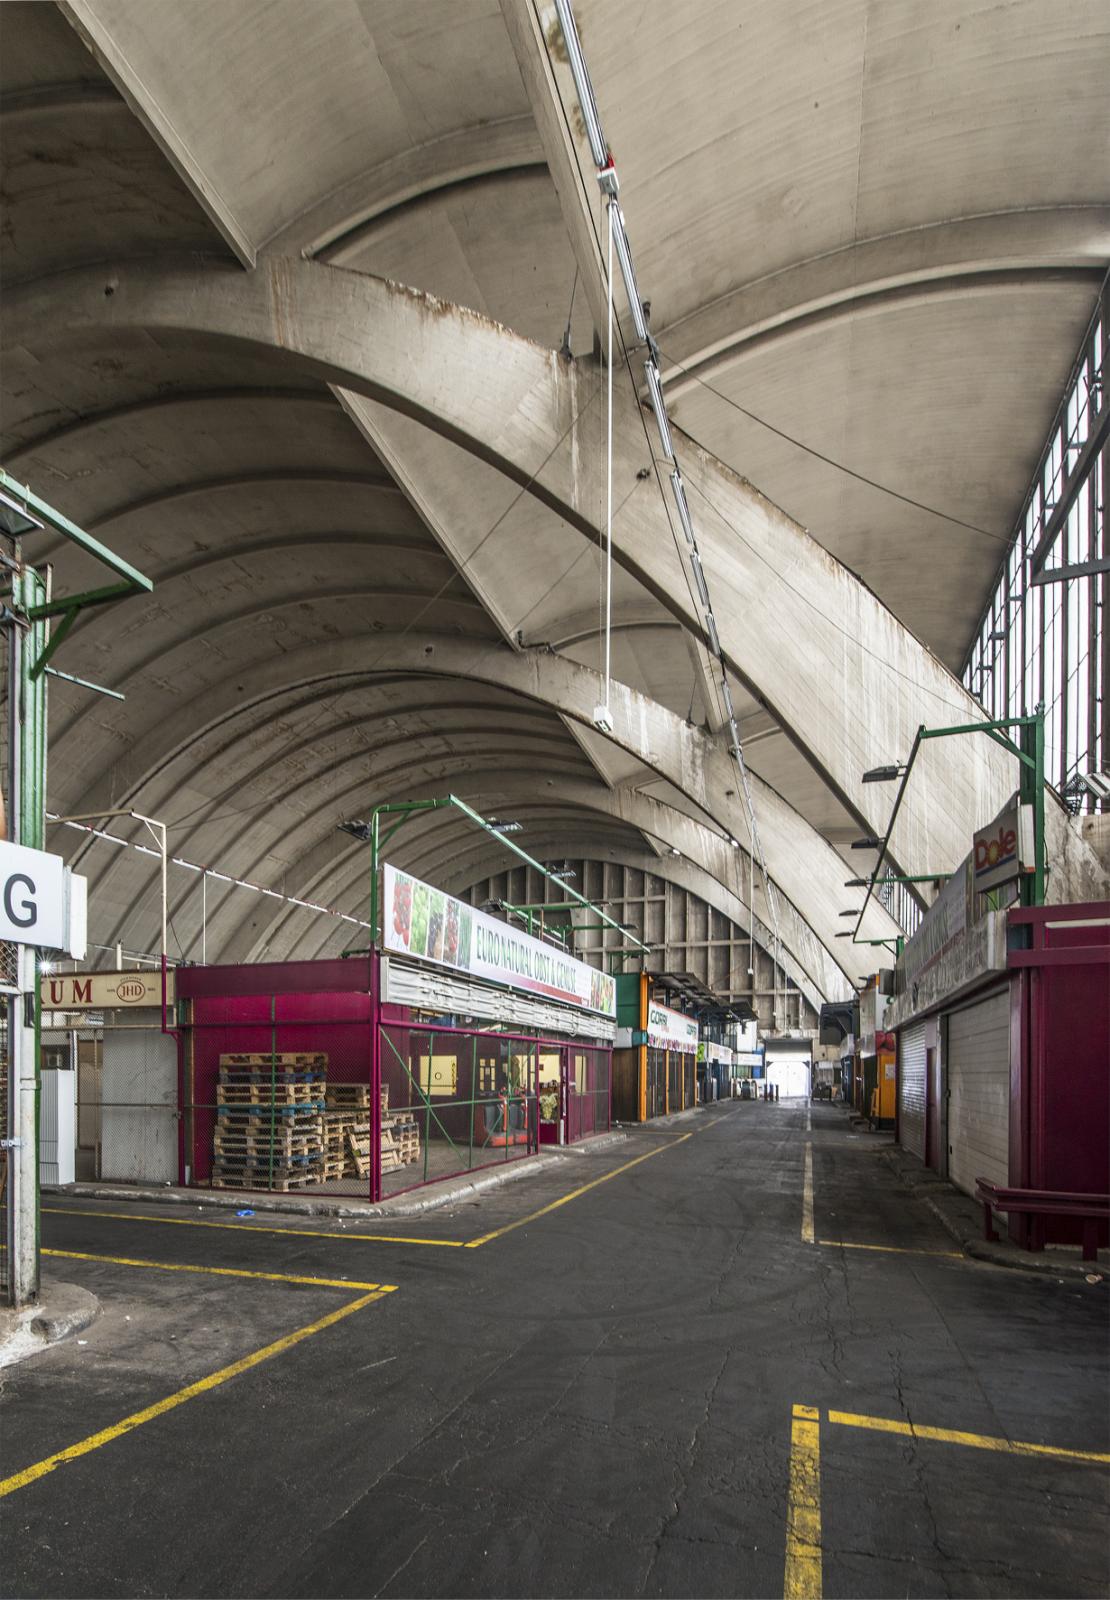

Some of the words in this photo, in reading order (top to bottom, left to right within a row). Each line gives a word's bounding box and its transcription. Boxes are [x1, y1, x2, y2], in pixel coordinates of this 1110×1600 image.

[975, 826, 1016, 870] Dole
[4, 873, 38, 928] G
[534, 951, 550, 983] OBST
[121, 984, 142, 998] JHD
